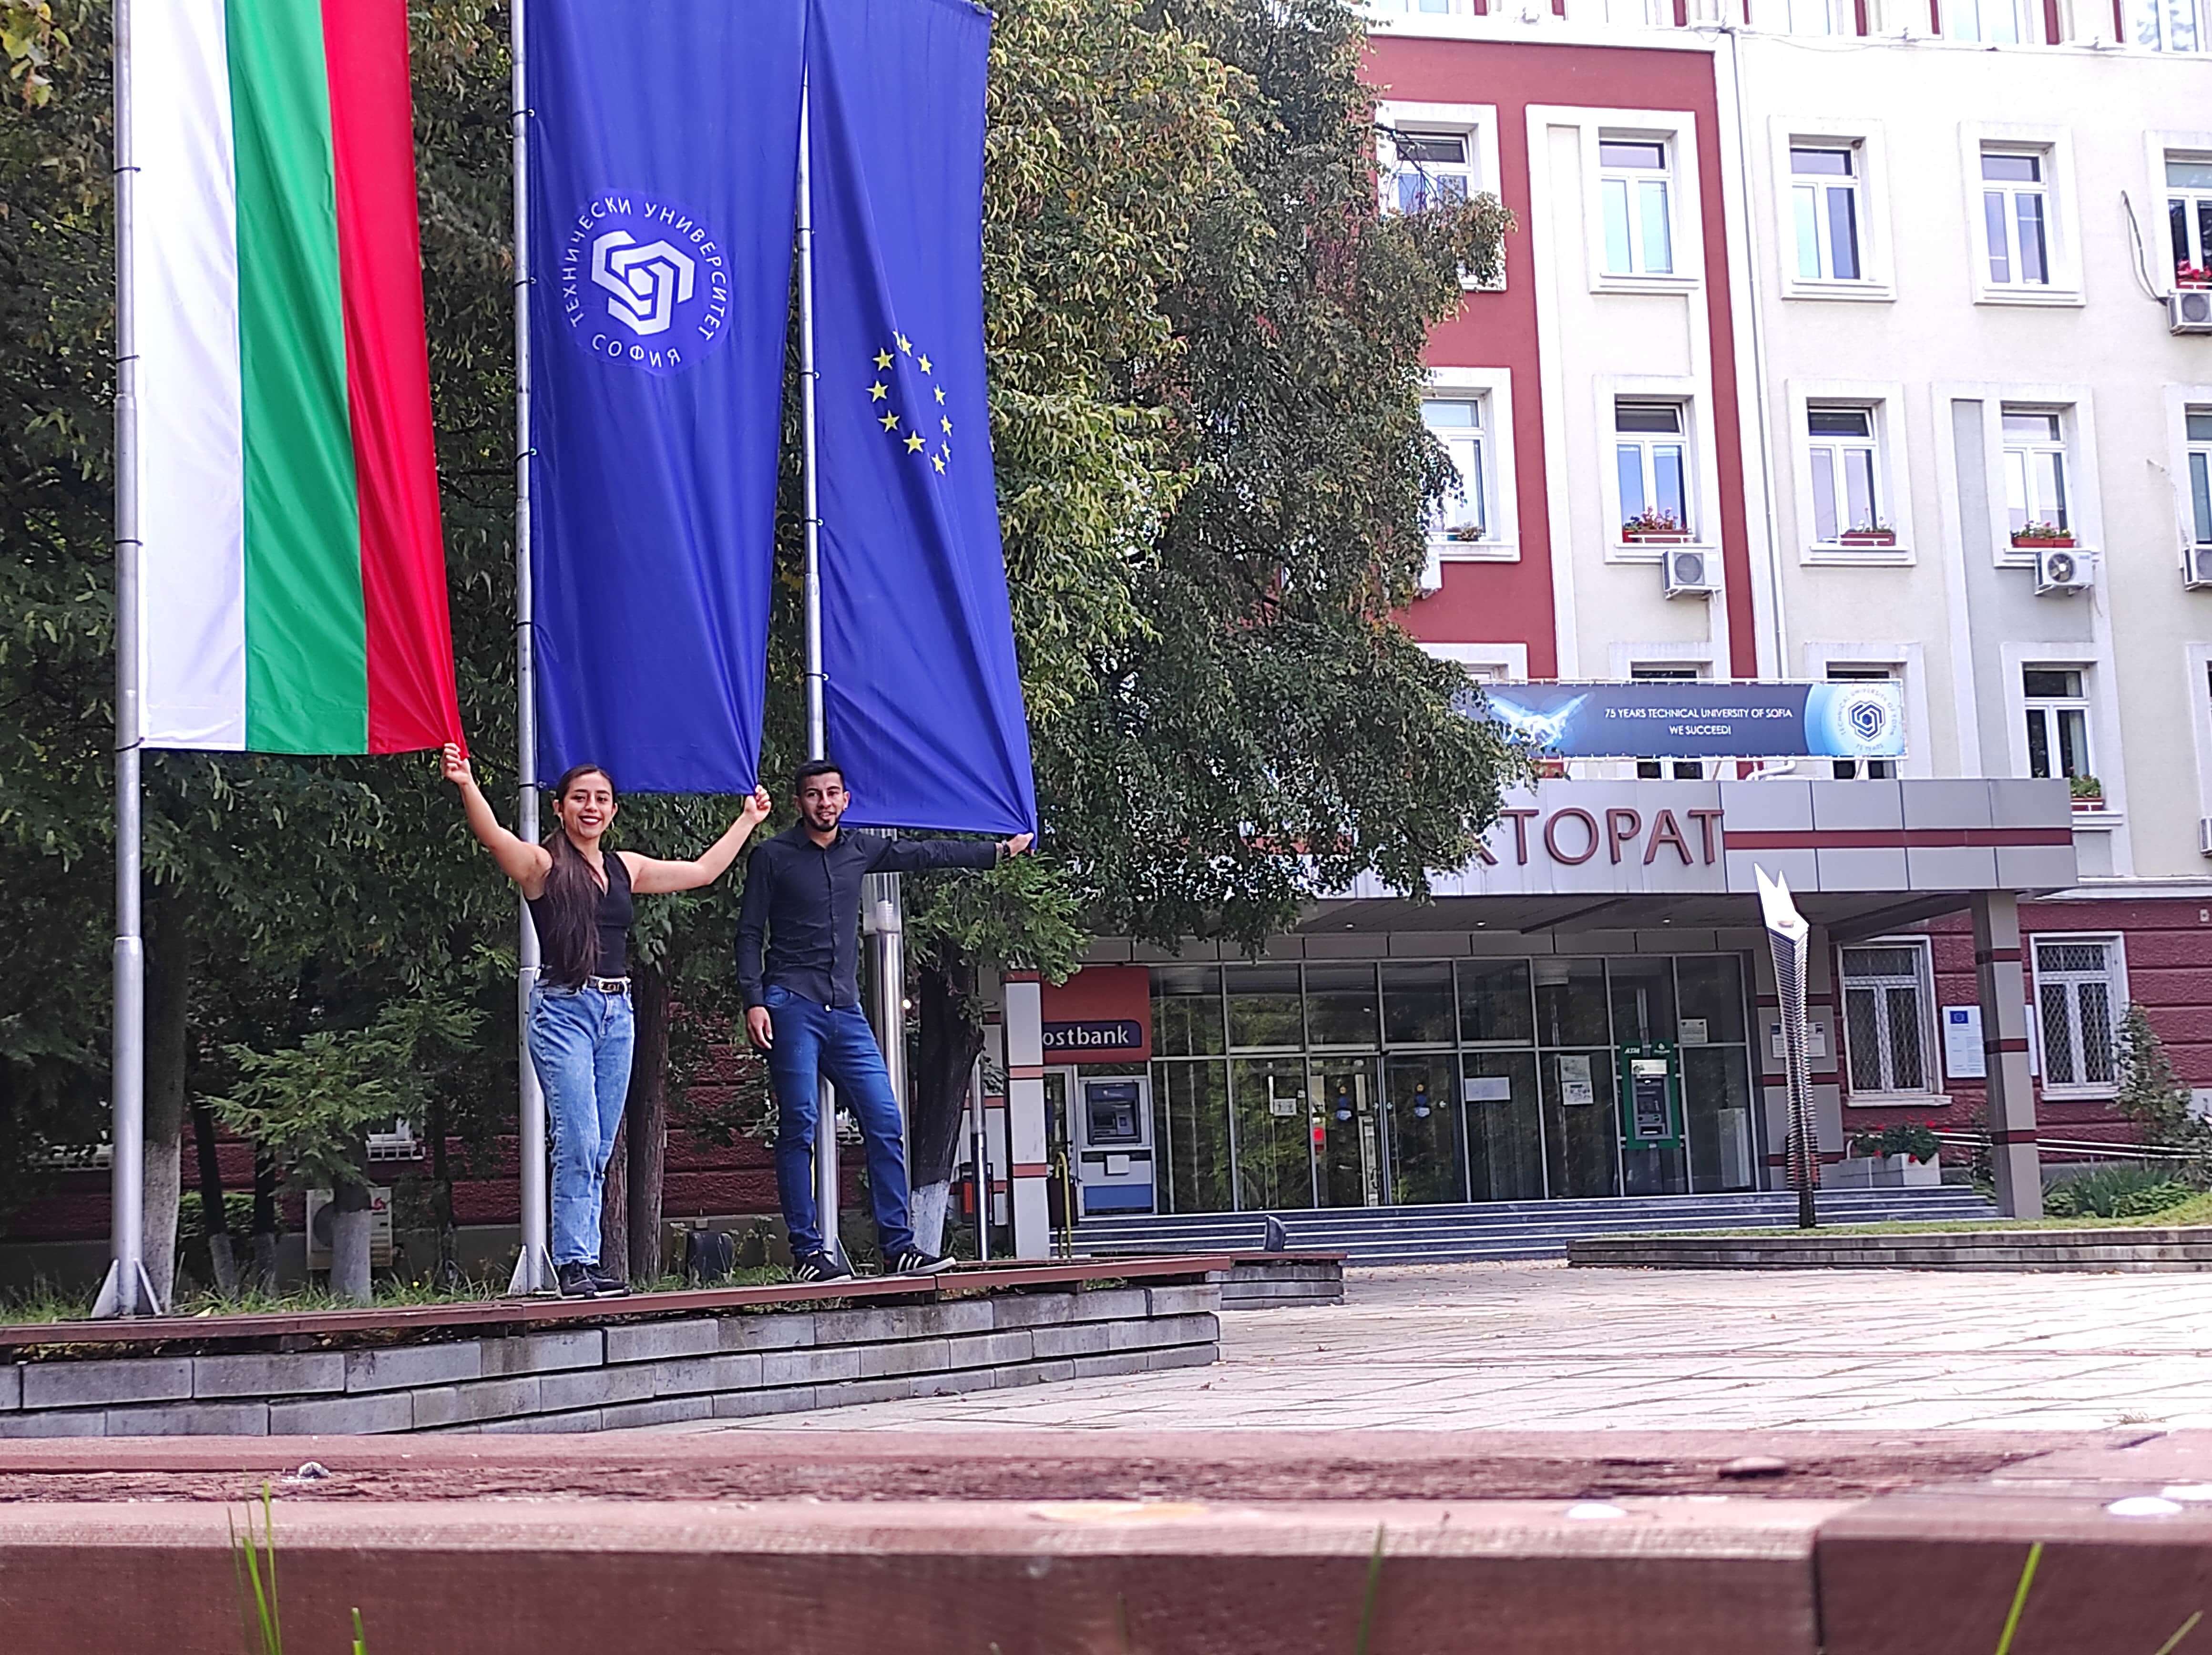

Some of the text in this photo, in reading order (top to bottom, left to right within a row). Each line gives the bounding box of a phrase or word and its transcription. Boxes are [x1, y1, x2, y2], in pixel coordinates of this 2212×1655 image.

[562, 196, 727, 341] ТЕХНИЧЕСКИ УНИВЕРСИТЕТ
[592, 334, 681, 368] СОФИЯ
[1605, 708, 1792, 718] 75 YEARS TECHNICAL UNIVERSITY OF SOFIA
[1669, 725, 1731, 736] WE SUCCEED!
[1042, 1025, 1129, 1045] ostbank
